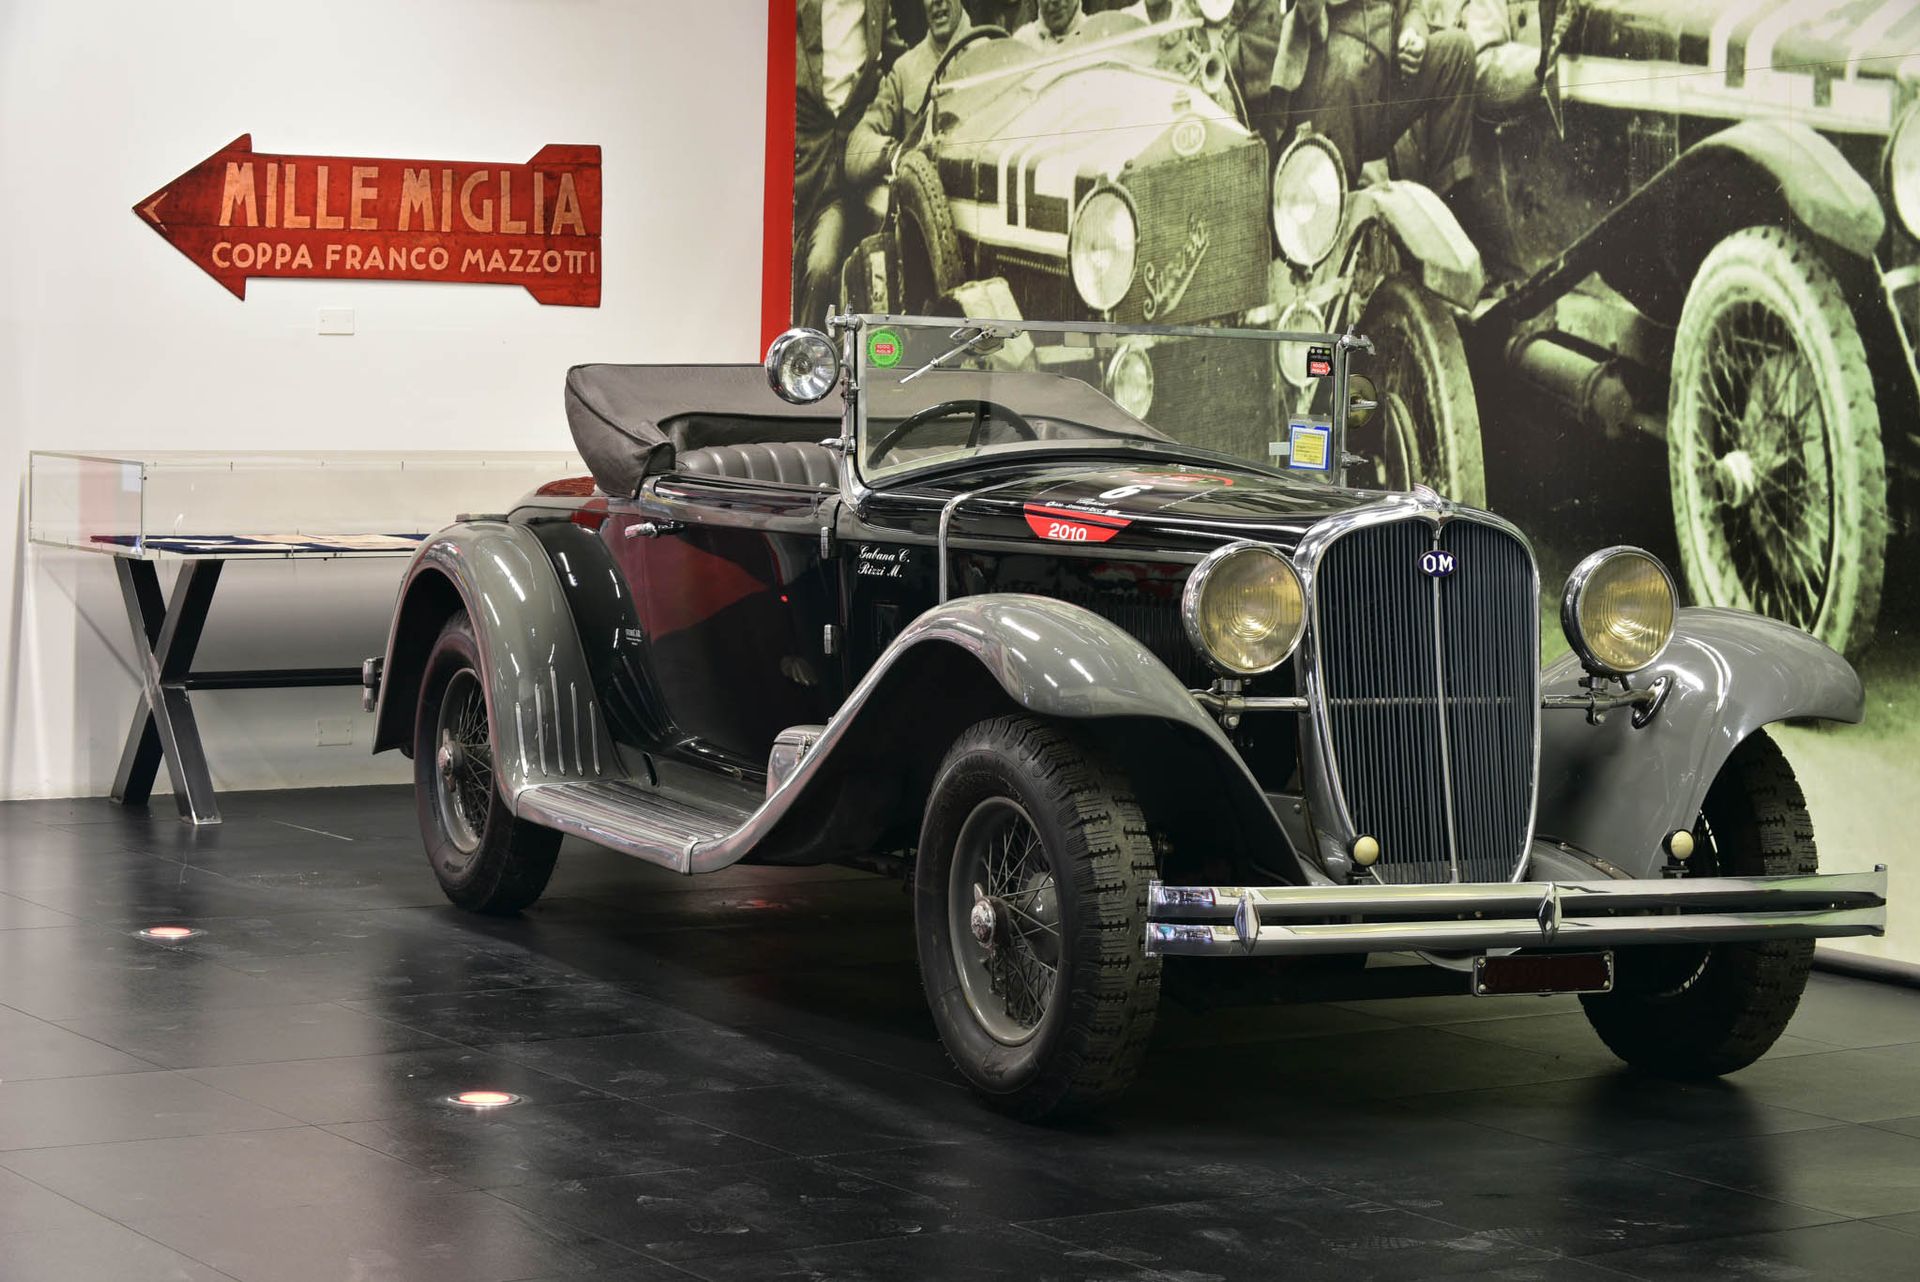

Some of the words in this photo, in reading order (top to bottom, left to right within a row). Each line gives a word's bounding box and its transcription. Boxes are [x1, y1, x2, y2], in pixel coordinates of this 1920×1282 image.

[219, 162, 379, 230] MILLE
[398, 168, 586, 236] MIGLIA
[212, 242, 313, 270] COPPA
[326, 244, 449, 271] FRANCO
[461, 249, 595, 274] MAZZOTTI
[1048, 522, 1087, 541] 2010
[859, 545, 896, 561] Gabana
[1423, 554, 1454, 573] OM
